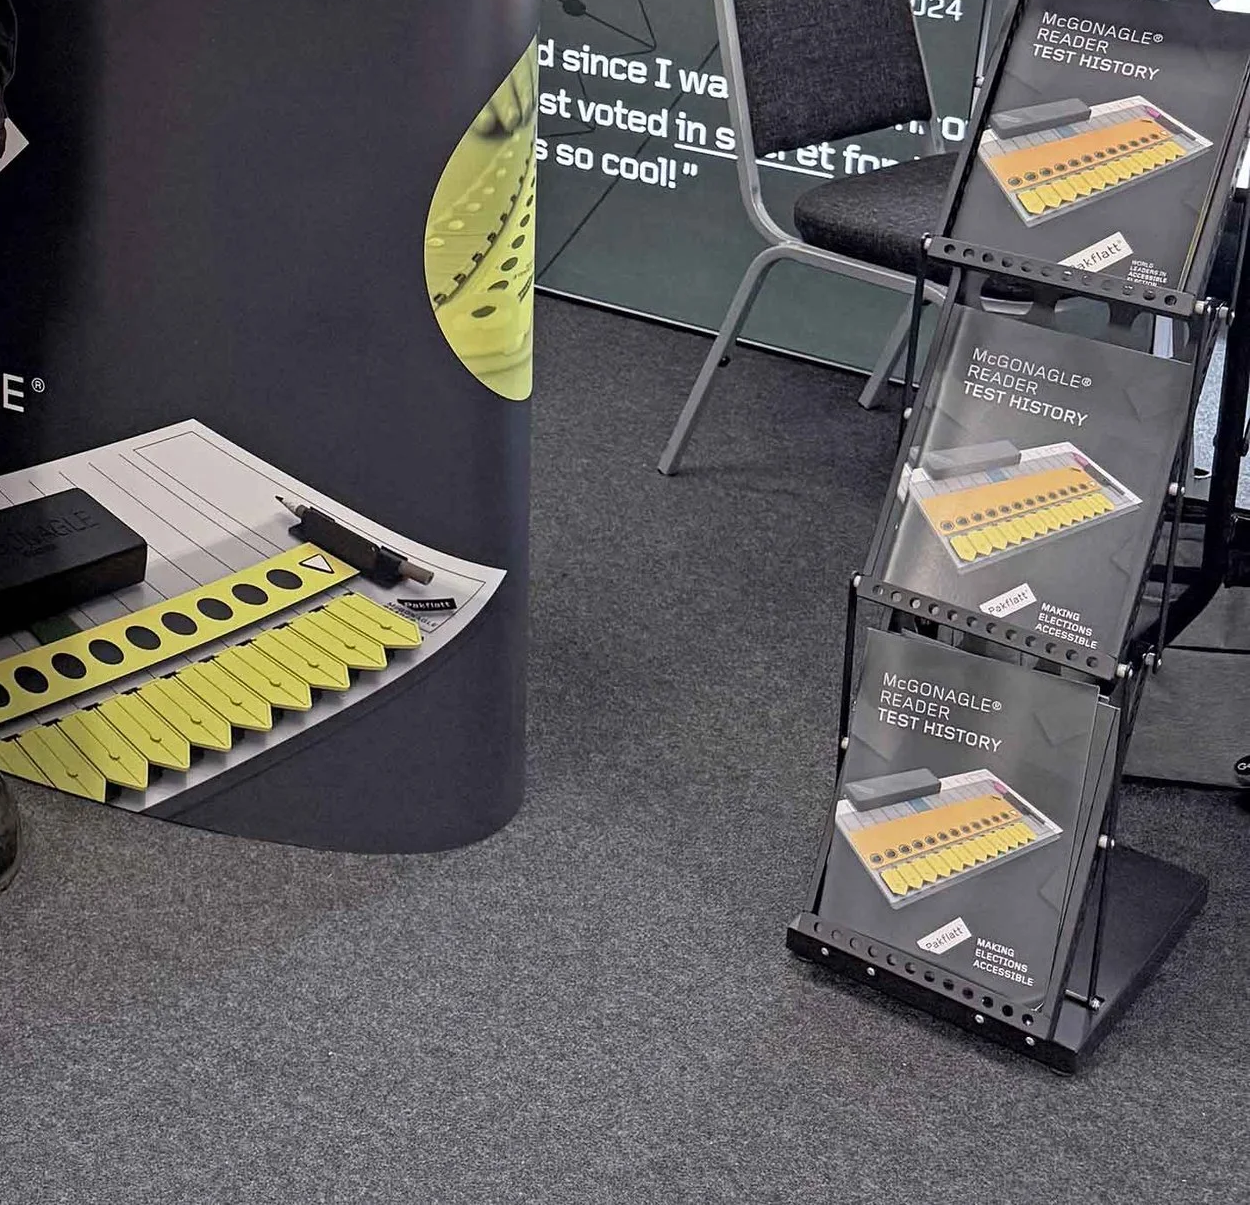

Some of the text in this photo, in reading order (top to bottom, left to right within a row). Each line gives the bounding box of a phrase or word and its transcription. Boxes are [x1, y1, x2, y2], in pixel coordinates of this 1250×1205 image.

[1036, 28, 1108, 54] READER
[1042, 11, 1164, 44] McGONAGLE®
[562, 44, 648, 84] since
[654, 58, 672, 89] I
[679, 68, 730, 99] wa
[1032, 44, 1160, 81] TEST HISTORY
[577, 99, 668, 138] voted
[675, 111, 707, 145] in
[556, 143, 594, 170] so
[967, 364, 1038, 395] READER
[971, 347, 1092, 388] McGONAGLE®
[963, 381, 1089, 427] TEST HISTORY
[1038, 613, 1093, 637] ELECTIONS
[1040, 602, 1080, 622] MAKING
[1034, 623, 1098, 650] ACCESSIBLE
[879, 690, 950, 720] READER
[882, 672, 1002, 713] McGONAGLE®
[877, 707, 1002, 753] TEST HISTORY
[974, 948, 1028, 973] ELECTIONS
[976, 937, 1015, 957] MAKING
[972, 959, 1035, 987] ACCESSIBLE
